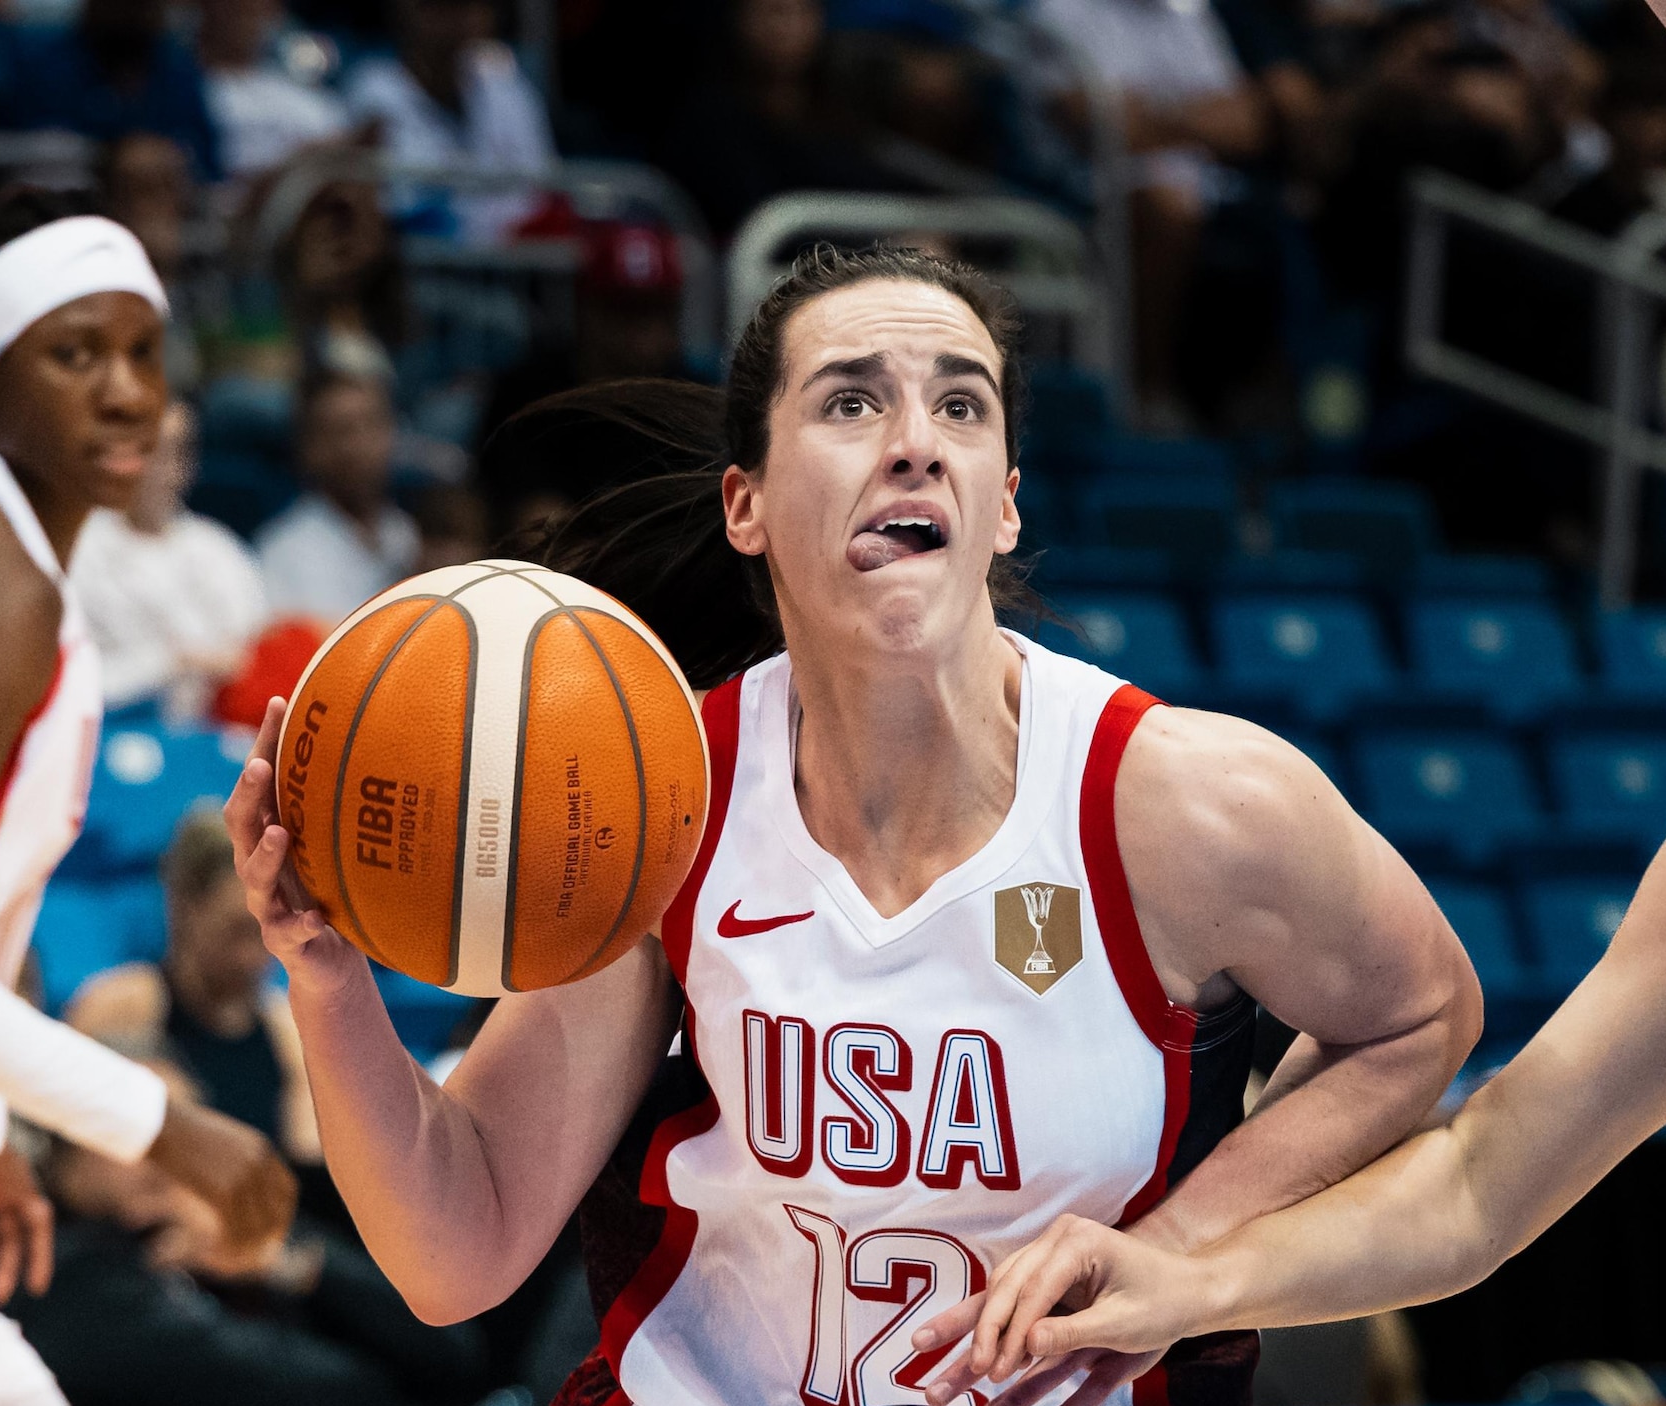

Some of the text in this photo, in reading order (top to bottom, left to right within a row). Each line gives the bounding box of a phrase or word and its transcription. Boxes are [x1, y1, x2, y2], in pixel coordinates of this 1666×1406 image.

[356, 775, 398, 871] FIBA
[398, 783, 420, 875] APPROVED
[476, 797, 502, 879] BG5000
[556, 753, 581, 919] FIBA OFFICIAL GAME BALL
[583, 790, 594, 835] LEATHER
[742, 1008, 1023, 1191] USA
